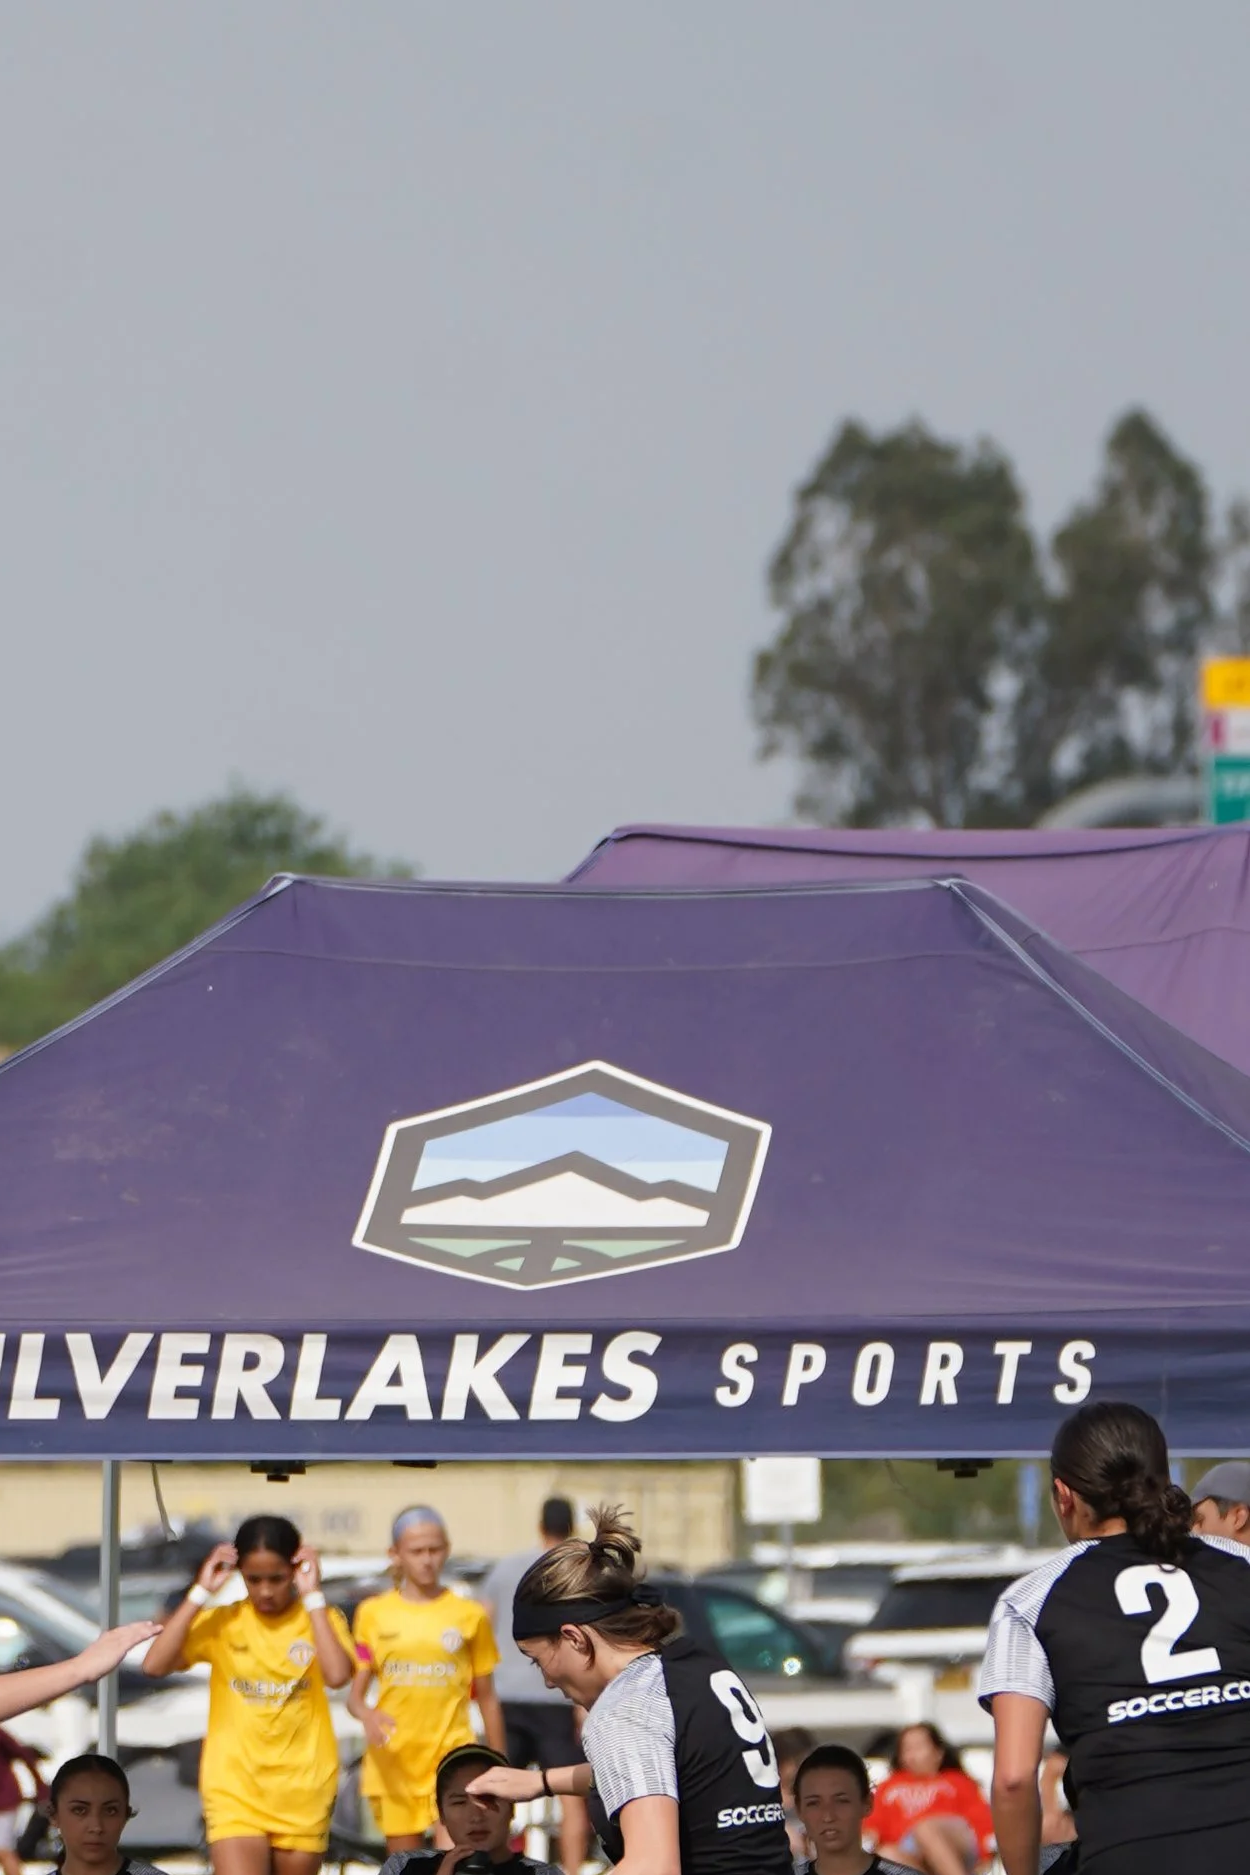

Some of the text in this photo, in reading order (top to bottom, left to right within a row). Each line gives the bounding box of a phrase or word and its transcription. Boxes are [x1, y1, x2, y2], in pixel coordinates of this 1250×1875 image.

[715, 1340, 1097, 1407] SPORTS
[1114, 1563, 1222, 1684] 2
[710, 1669, 781, 1788] 9
